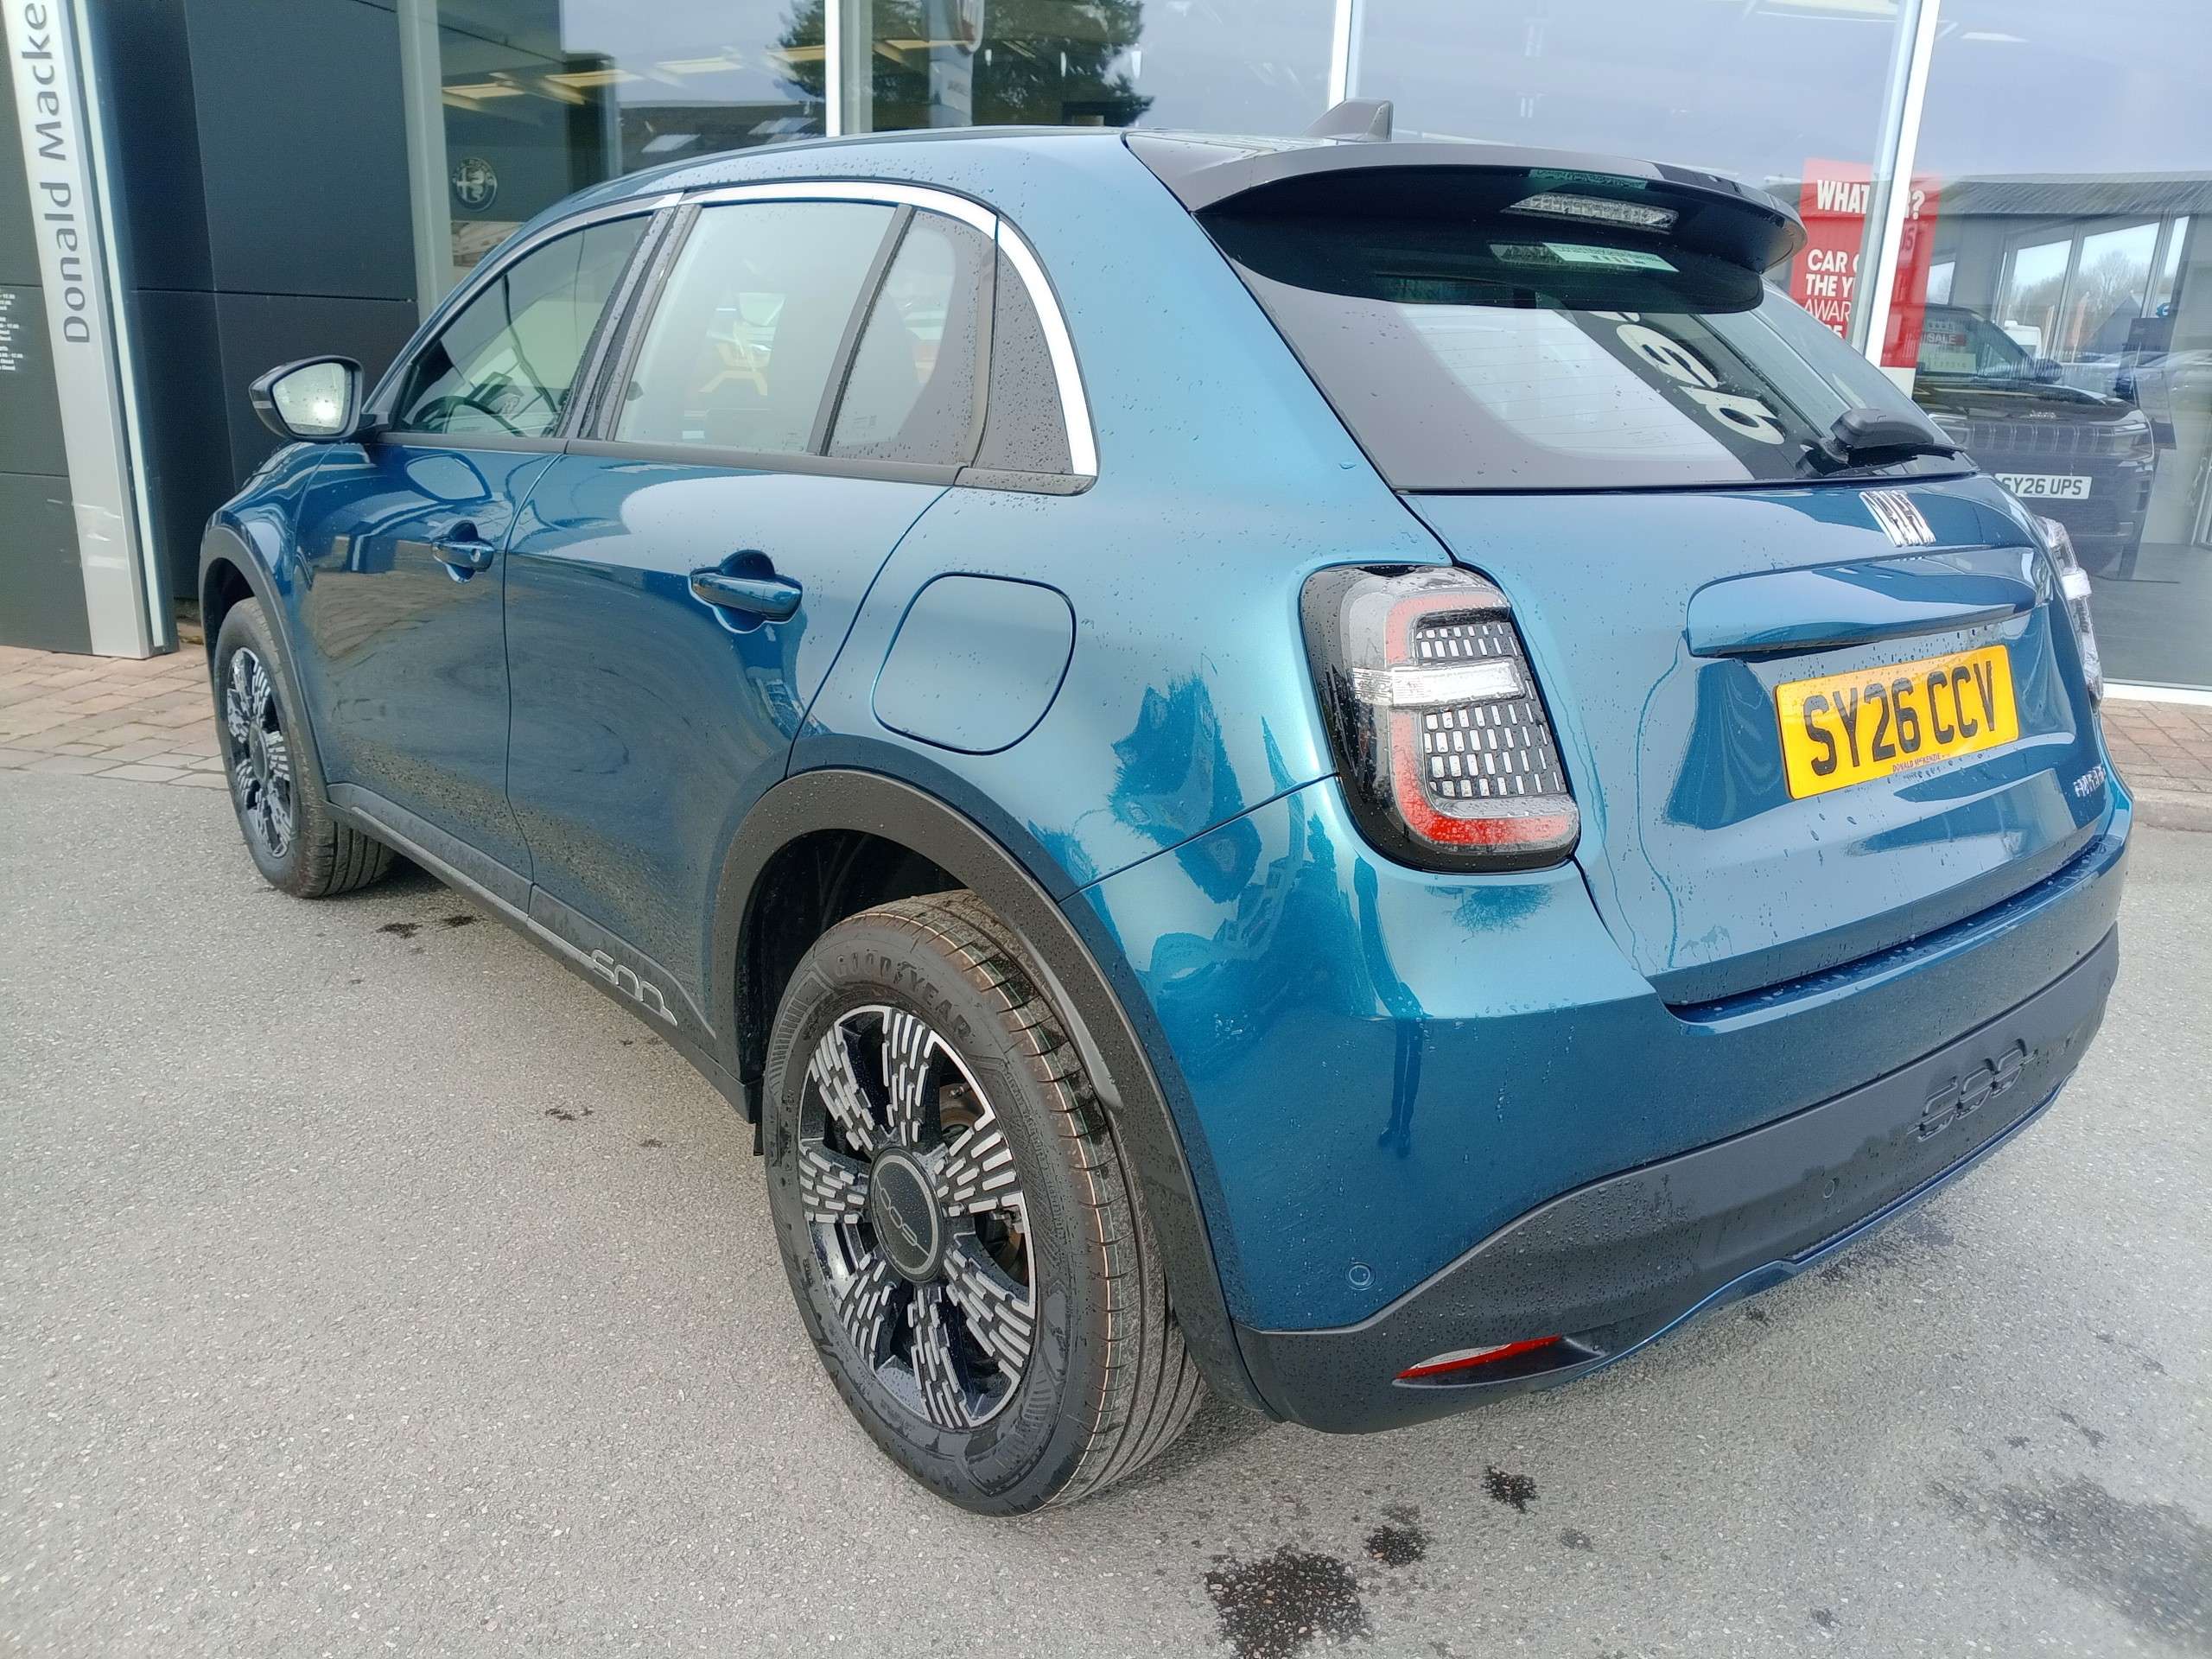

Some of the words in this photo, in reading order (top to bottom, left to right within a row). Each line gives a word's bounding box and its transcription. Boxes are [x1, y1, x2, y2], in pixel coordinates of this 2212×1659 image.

[40, 181, 90, 343] Donald
[1807, 248, 1849, 274] CAR
[1805, 273, 1838, 297] THE
[2050, 479, 2083, 496] UPS
[1802, 676, 1922, 777] SY26
[1926, 660, 1996, 745] CCV
